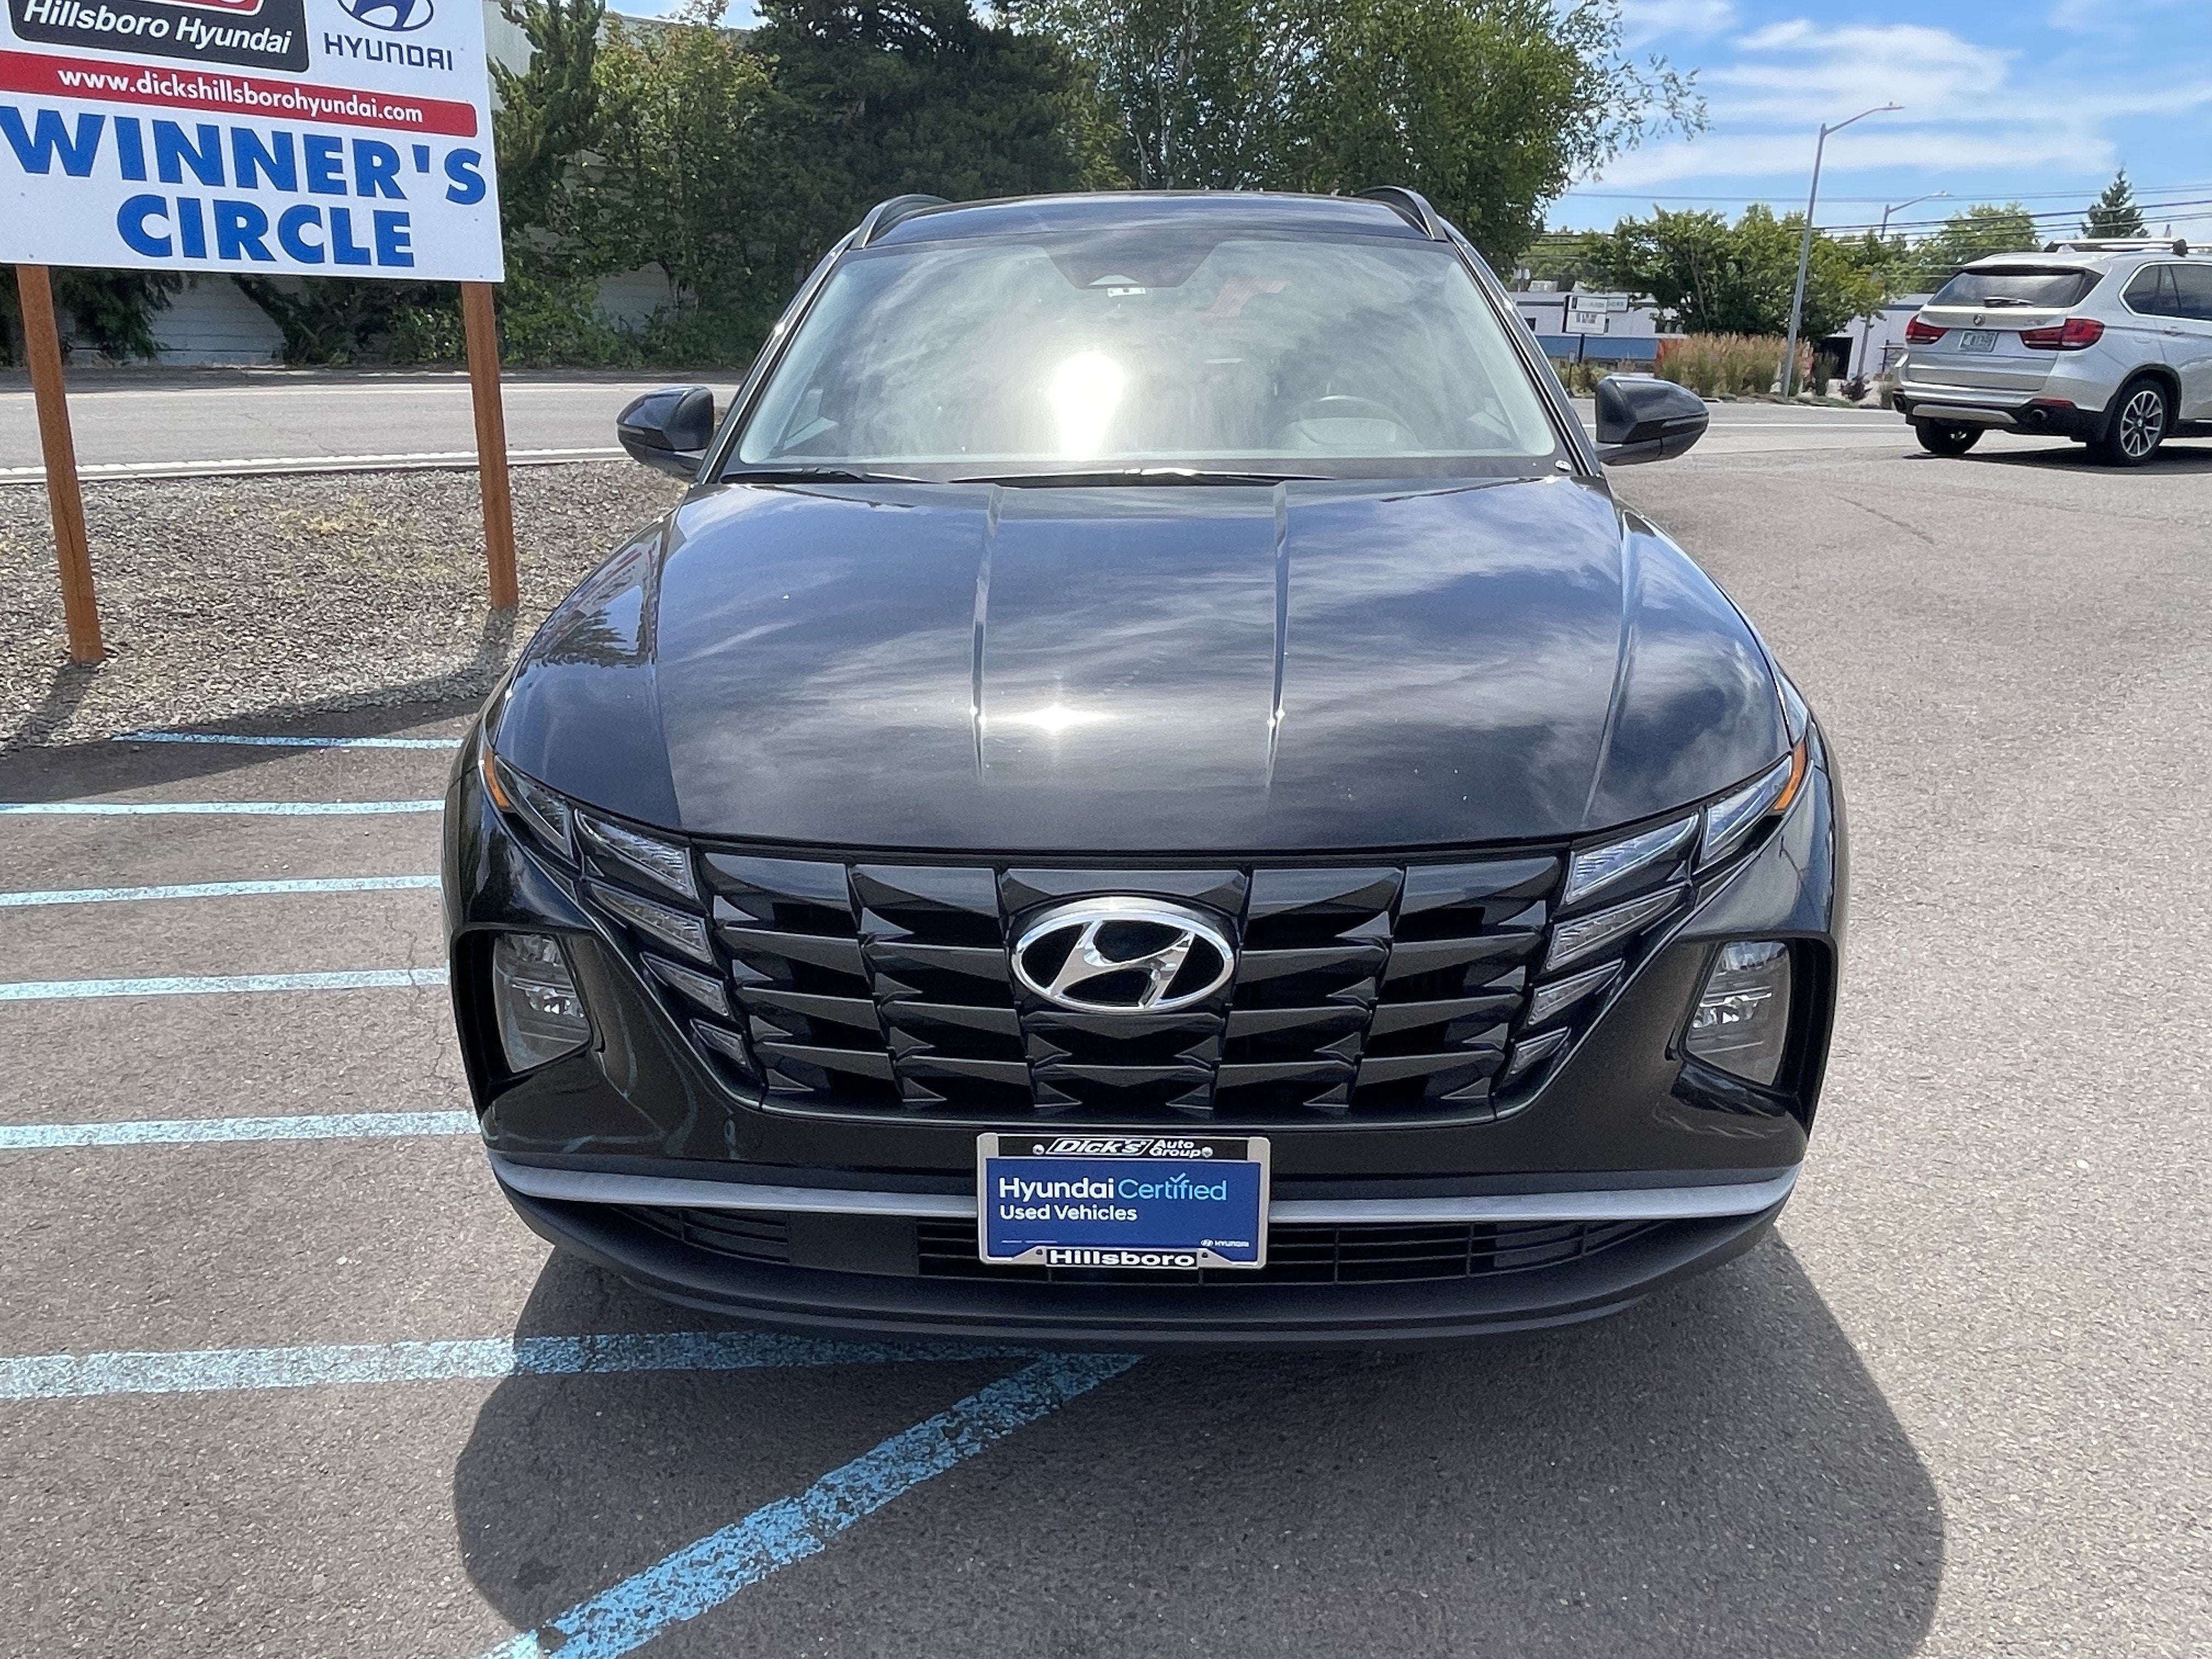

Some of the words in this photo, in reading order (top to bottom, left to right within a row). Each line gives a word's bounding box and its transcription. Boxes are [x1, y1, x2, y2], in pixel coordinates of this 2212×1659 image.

[23, 0, 170, 38] Hillsboro
[175, 16, 292, 54] Hyundai
[324, 32, 453, 71] HYUNDAI
[58, 69, 423, 124] www.dickshillsborohyundai.com
[0, 106, 487, 205] WINNER'S
[116, 194, 415, 268] CIRCLE
[1149, 1148, 1201, 1159] Group
[1154, 1139, 1194, 1149] Auto
[998, 1177, 1114, 1202] Hyundai
[1118, 1173, 1227, 1201] Certified
[1000, 1205, 1050, 1220] Used
[1054, 1204, 1138, 1221] Vehicles
[1050, 1250, 1195, 1267] Hillsboro
